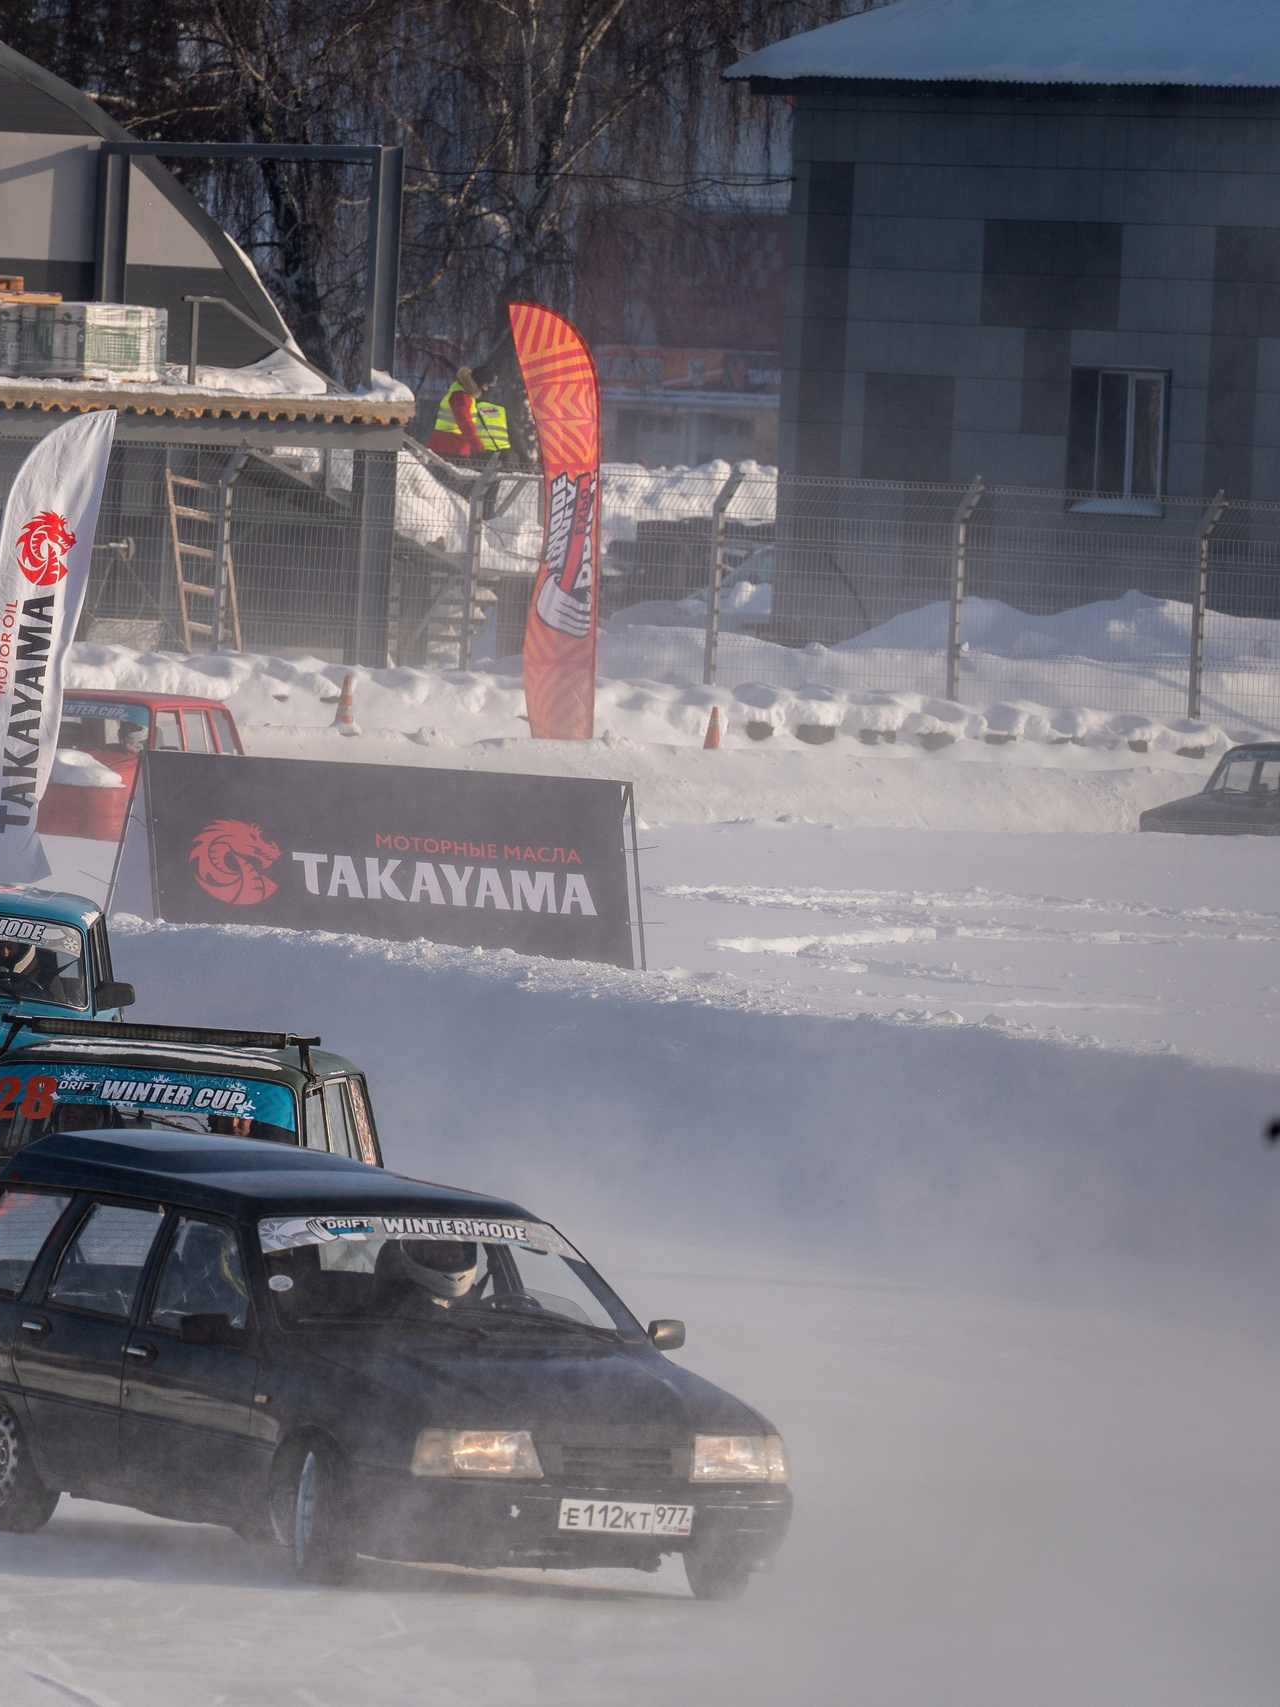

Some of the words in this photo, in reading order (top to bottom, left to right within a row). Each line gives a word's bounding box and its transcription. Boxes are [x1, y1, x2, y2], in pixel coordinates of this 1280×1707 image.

[3, 599, 18, 628] OIL
[62, 703, 97, 715] INTER
[98, 706, 124, 718] CUP
[375, 833, 497, 859] МОТОРНЫЕ
[504, 844, 582, 864] МАСЛА
[292, 850, 598, 916] TAKAYAMA
[58, 1080, 101, 1091] DRIFT
[101, 1079, 191, 1105] WINTER
[192, 1087, 247, 1111] CUP
[326, 1219, 370, 1229] DRIFT
[381, 1217, 470, 1236] WINTER
[470, 1221, 529, 1241] MODE
[565, 1503, 652, 1530] Е112КТ
[655, 1506, 688, 1525] 977
[661, 1525, 678, 1533] RUS
